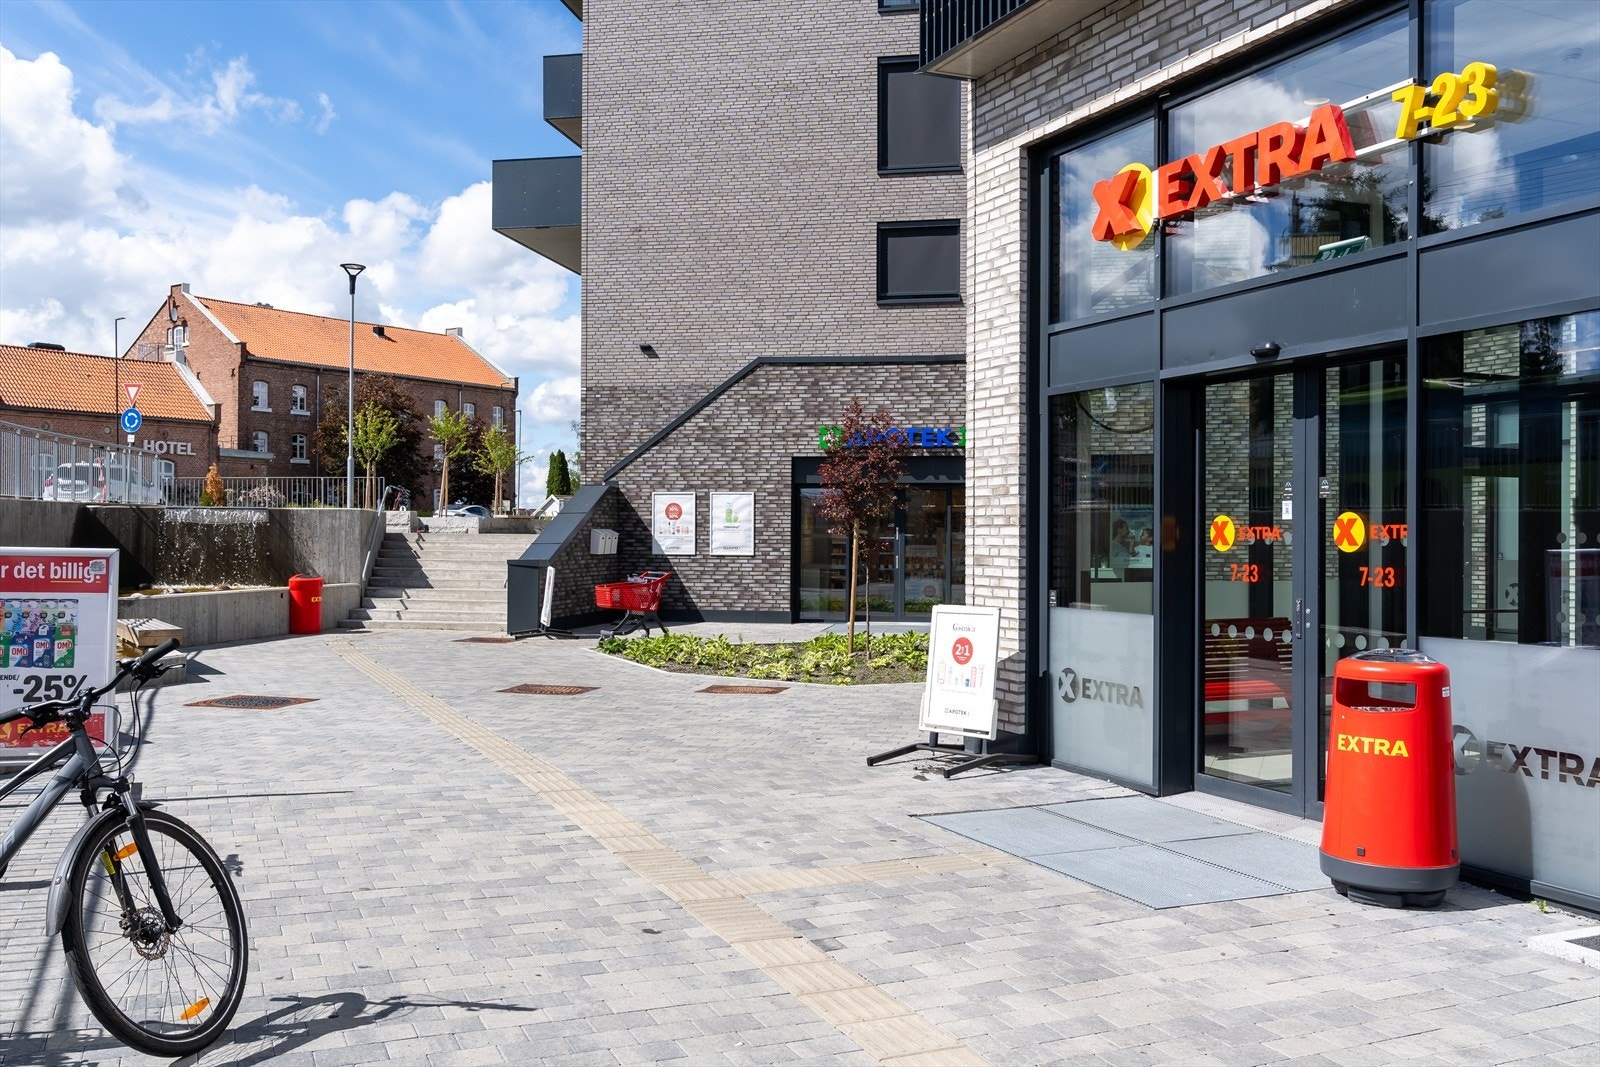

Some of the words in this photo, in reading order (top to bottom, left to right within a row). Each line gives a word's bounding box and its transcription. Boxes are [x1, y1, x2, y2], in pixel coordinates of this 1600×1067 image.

[1157, 104, 1357, 219] EXTRA
[1391, 61, 1498, 140] 7-23
[143, 440, 196, 456] HOTEL
[1238, 525, 1283, 540] EXTRA
[1370, 524, 1408, 539] EXTR
[13, 561, 45, 579] det
[1230, 564, 1259, 583] 7-23
[1360, 567, 1395, 587] 7-23
[11, 647, 28, 656] OMO
[36, 641, 50, 649] OMO
[57, 641, 73, 649] OMO
[13, 675, 87, 702] -25%
[1082, 677, 1144, 709] EXTRA
[17, 723, 69, 734] EXRA
[1337, 733, 1409, 758] EXTRA
